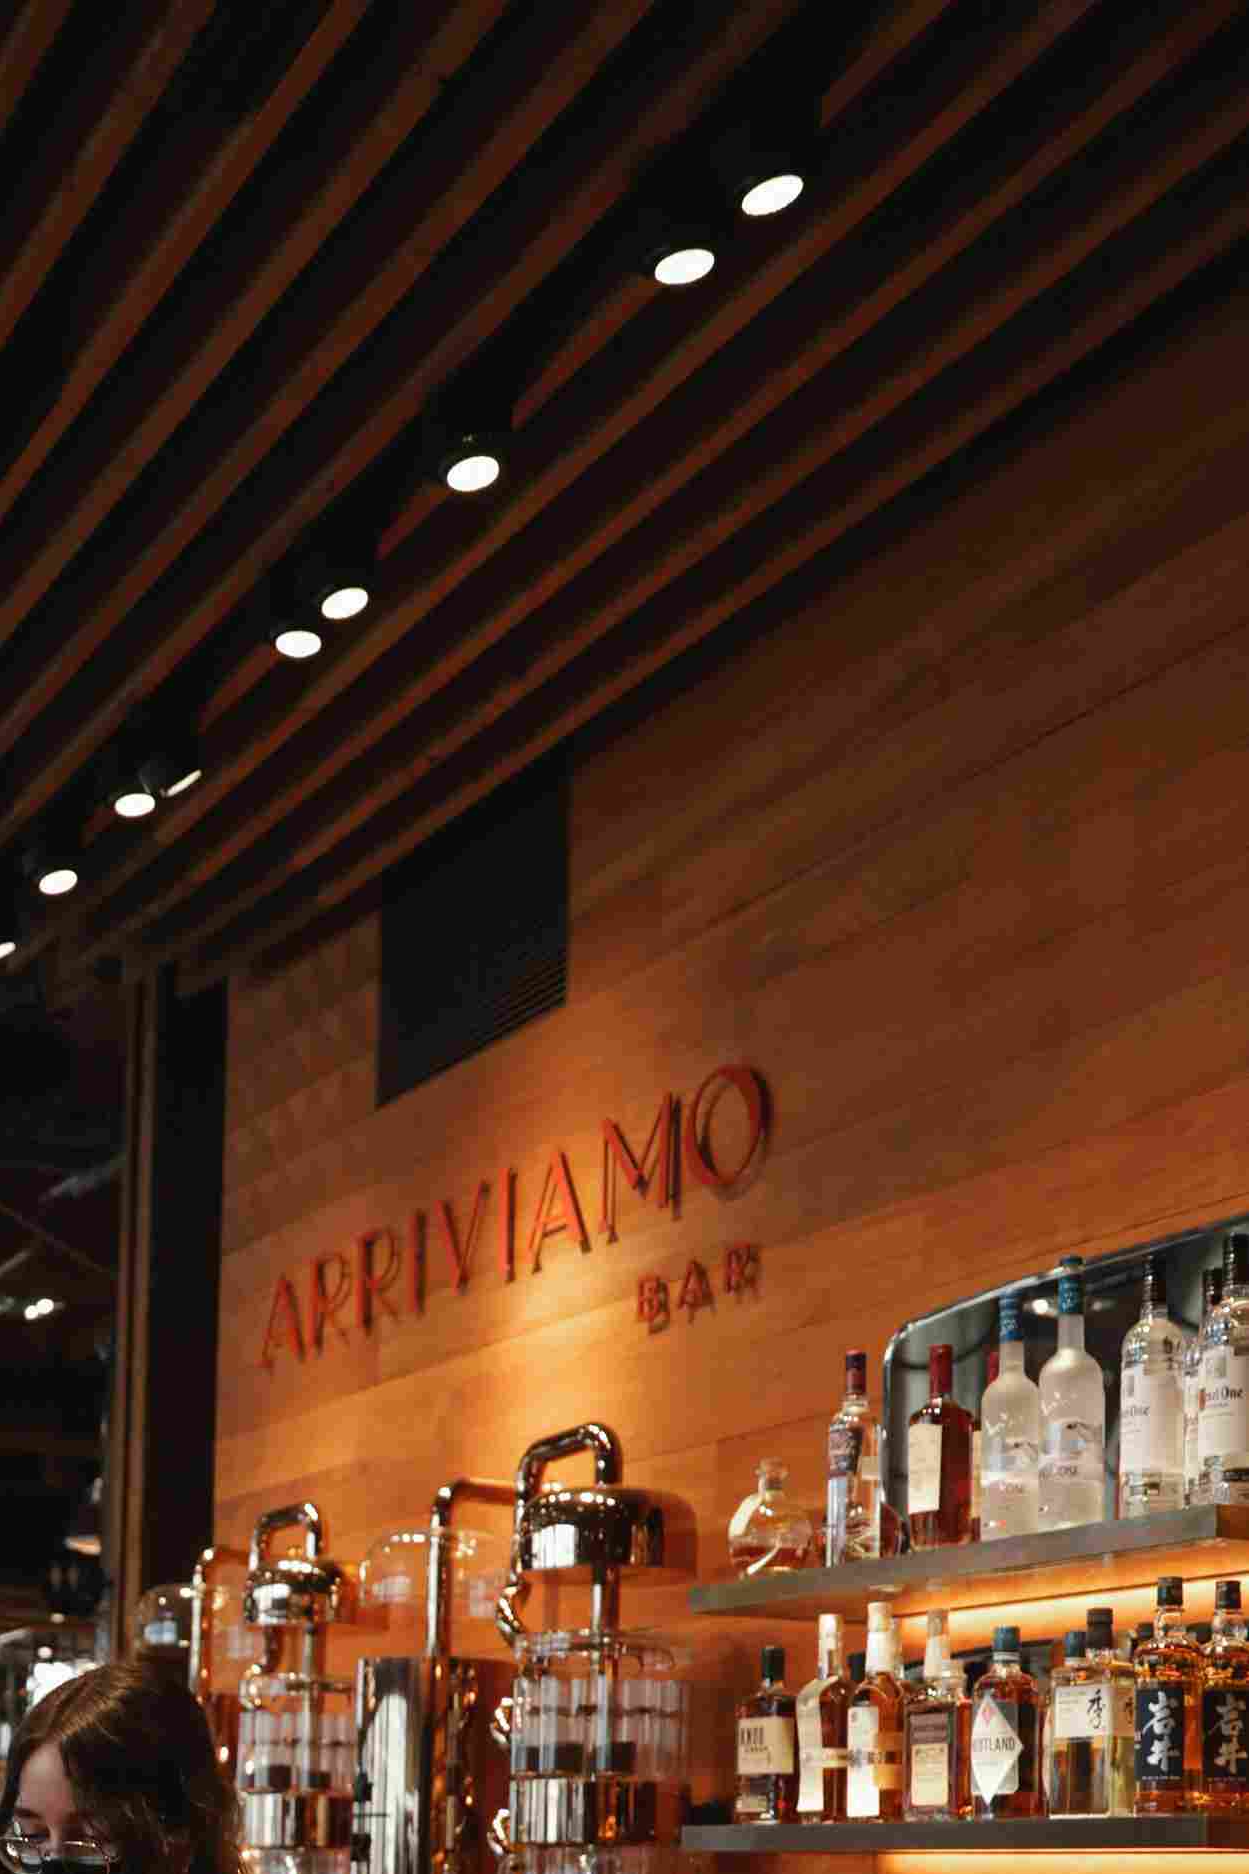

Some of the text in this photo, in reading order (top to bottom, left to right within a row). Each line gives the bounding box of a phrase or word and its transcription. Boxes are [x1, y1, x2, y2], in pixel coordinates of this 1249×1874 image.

[258, 1064, 773, 1373] ARRIVIAMO
[636, 1242, 762, 1333] BAR
[1142, 1690, 1181, 1772] 岩井
